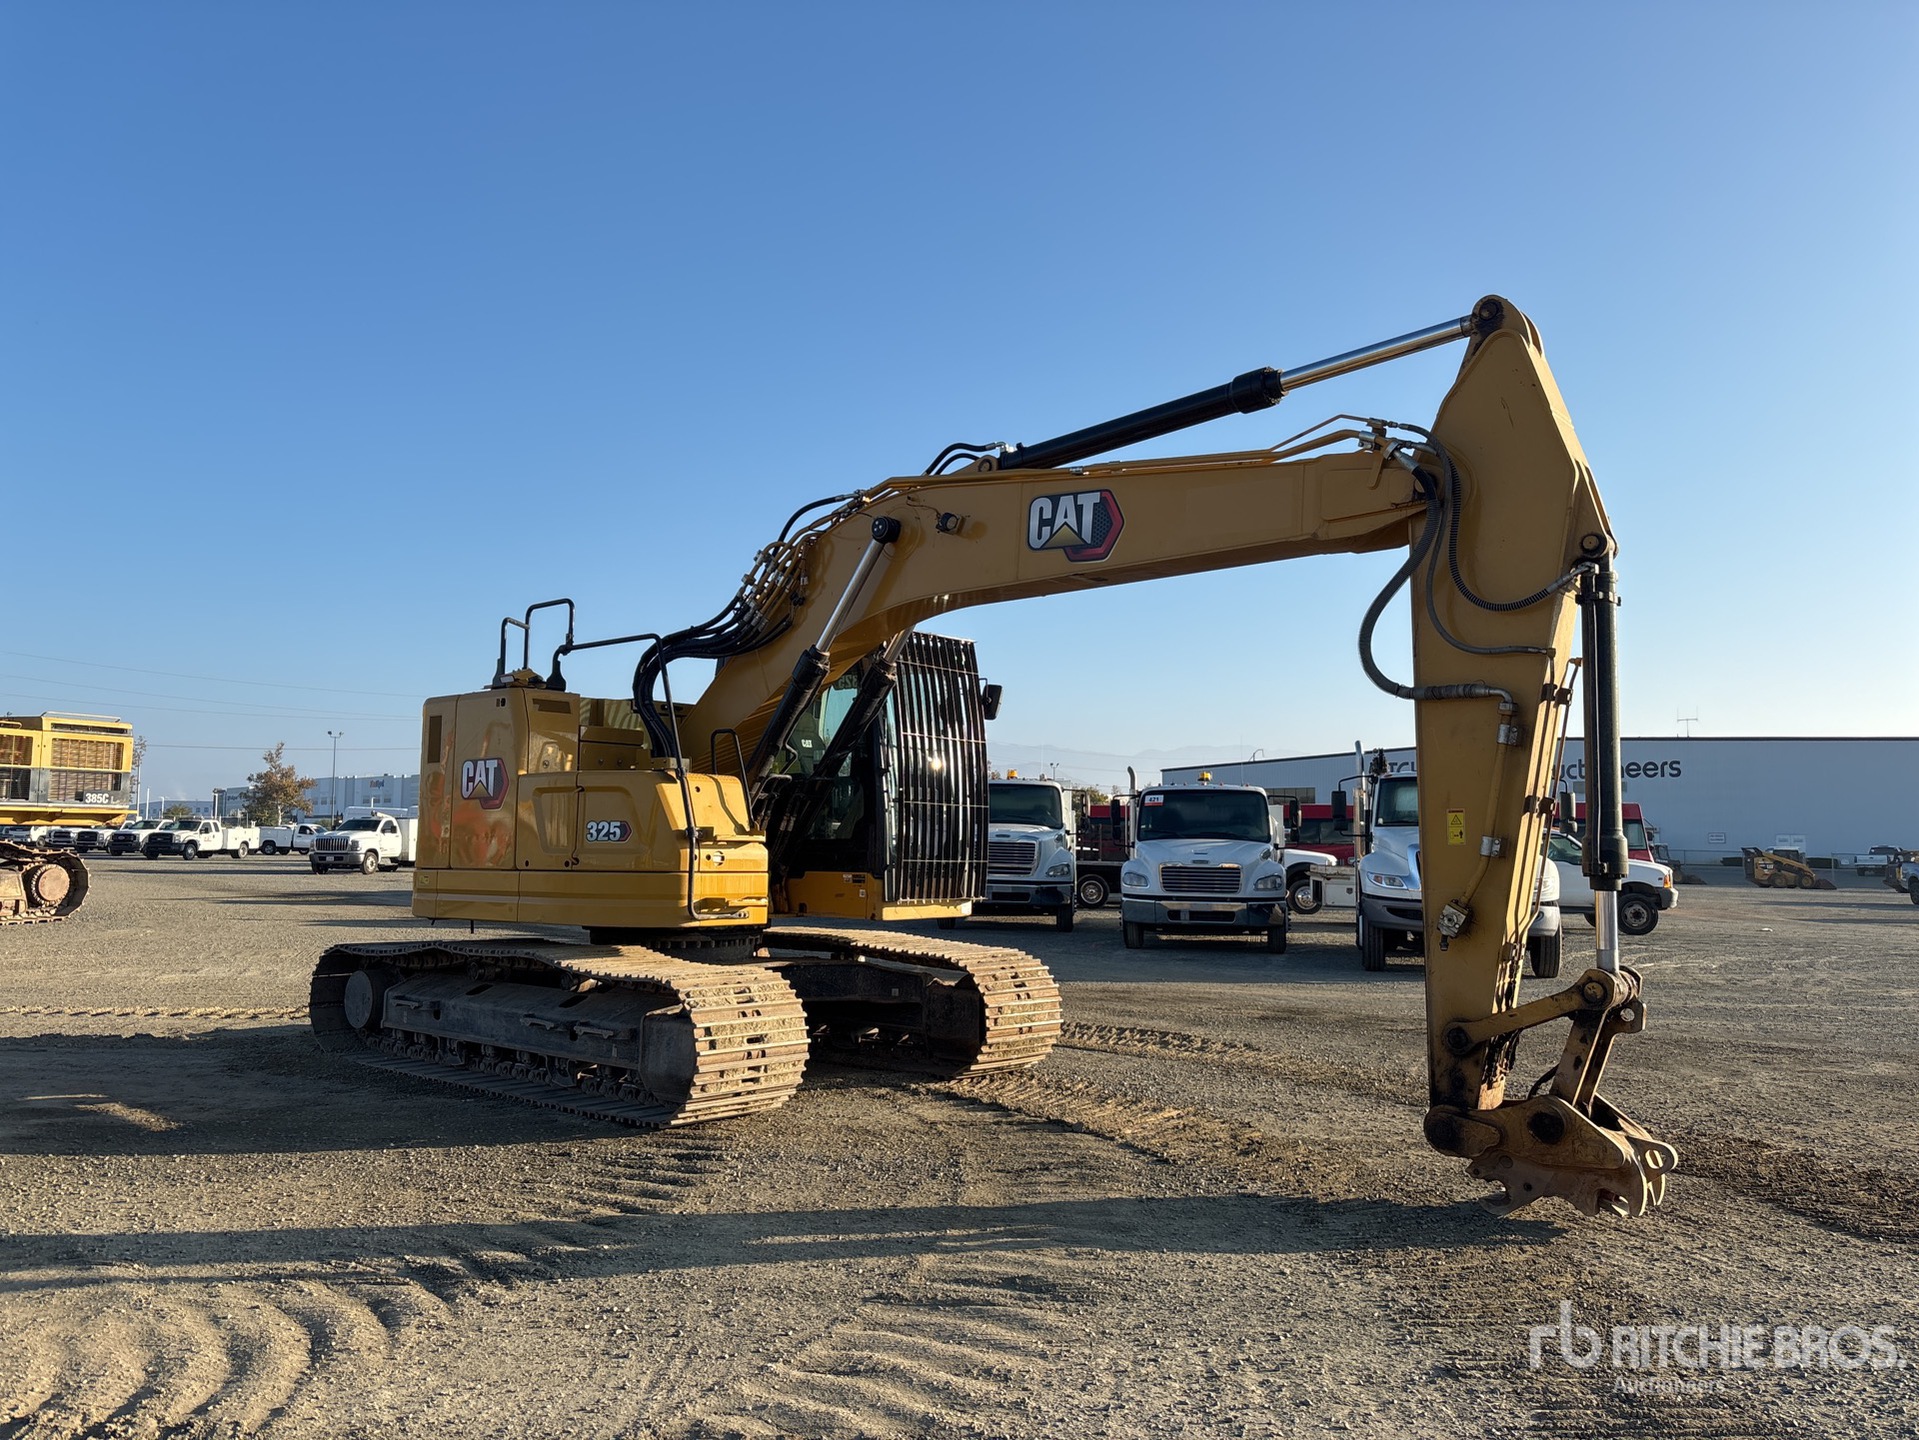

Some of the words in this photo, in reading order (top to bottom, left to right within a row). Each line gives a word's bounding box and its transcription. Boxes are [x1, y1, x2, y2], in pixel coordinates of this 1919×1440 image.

[1029, 491, 1101, 549] CAT
[462, 759, 498, 799] CAT
[85, 792, 109, 804] 385C
[586, 821, 621, 841] 325
